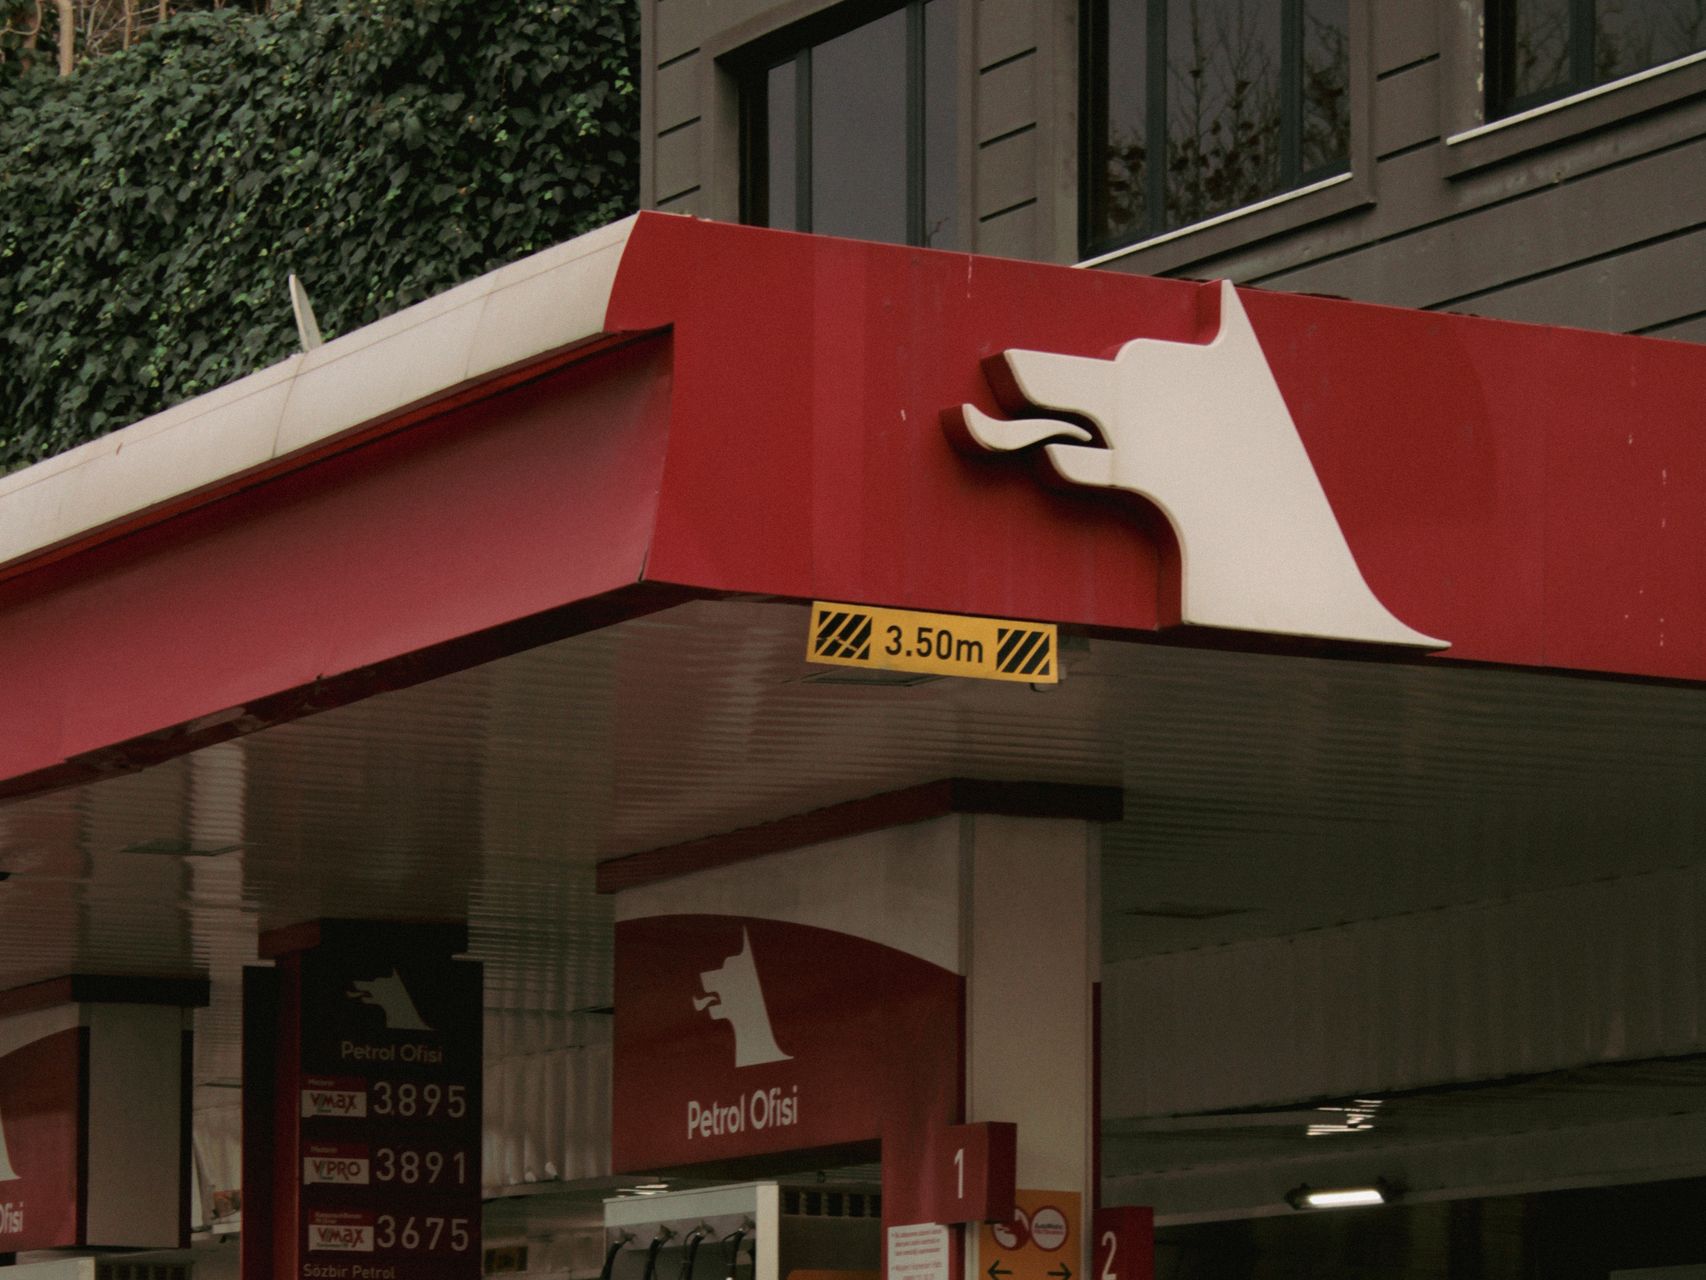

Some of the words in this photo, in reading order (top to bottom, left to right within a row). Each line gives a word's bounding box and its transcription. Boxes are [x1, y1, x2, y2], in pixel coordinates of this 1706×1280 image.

[885, 625, 983, 663] 3.50m
[341, 1040, 394, 1061] Petrol
[400, 1044, 442, 1063] Ofisi
[688, 1093, 745, 1140] Petrol
[750, 1084, 798, 1130] Ofisi
[376, 1148, 465, 1184] 3891
[954, 1148, 964, 1199] 1
[376, 1214, 469, 1251] 3675
[352, 1264, 396, 1280] Petrol
